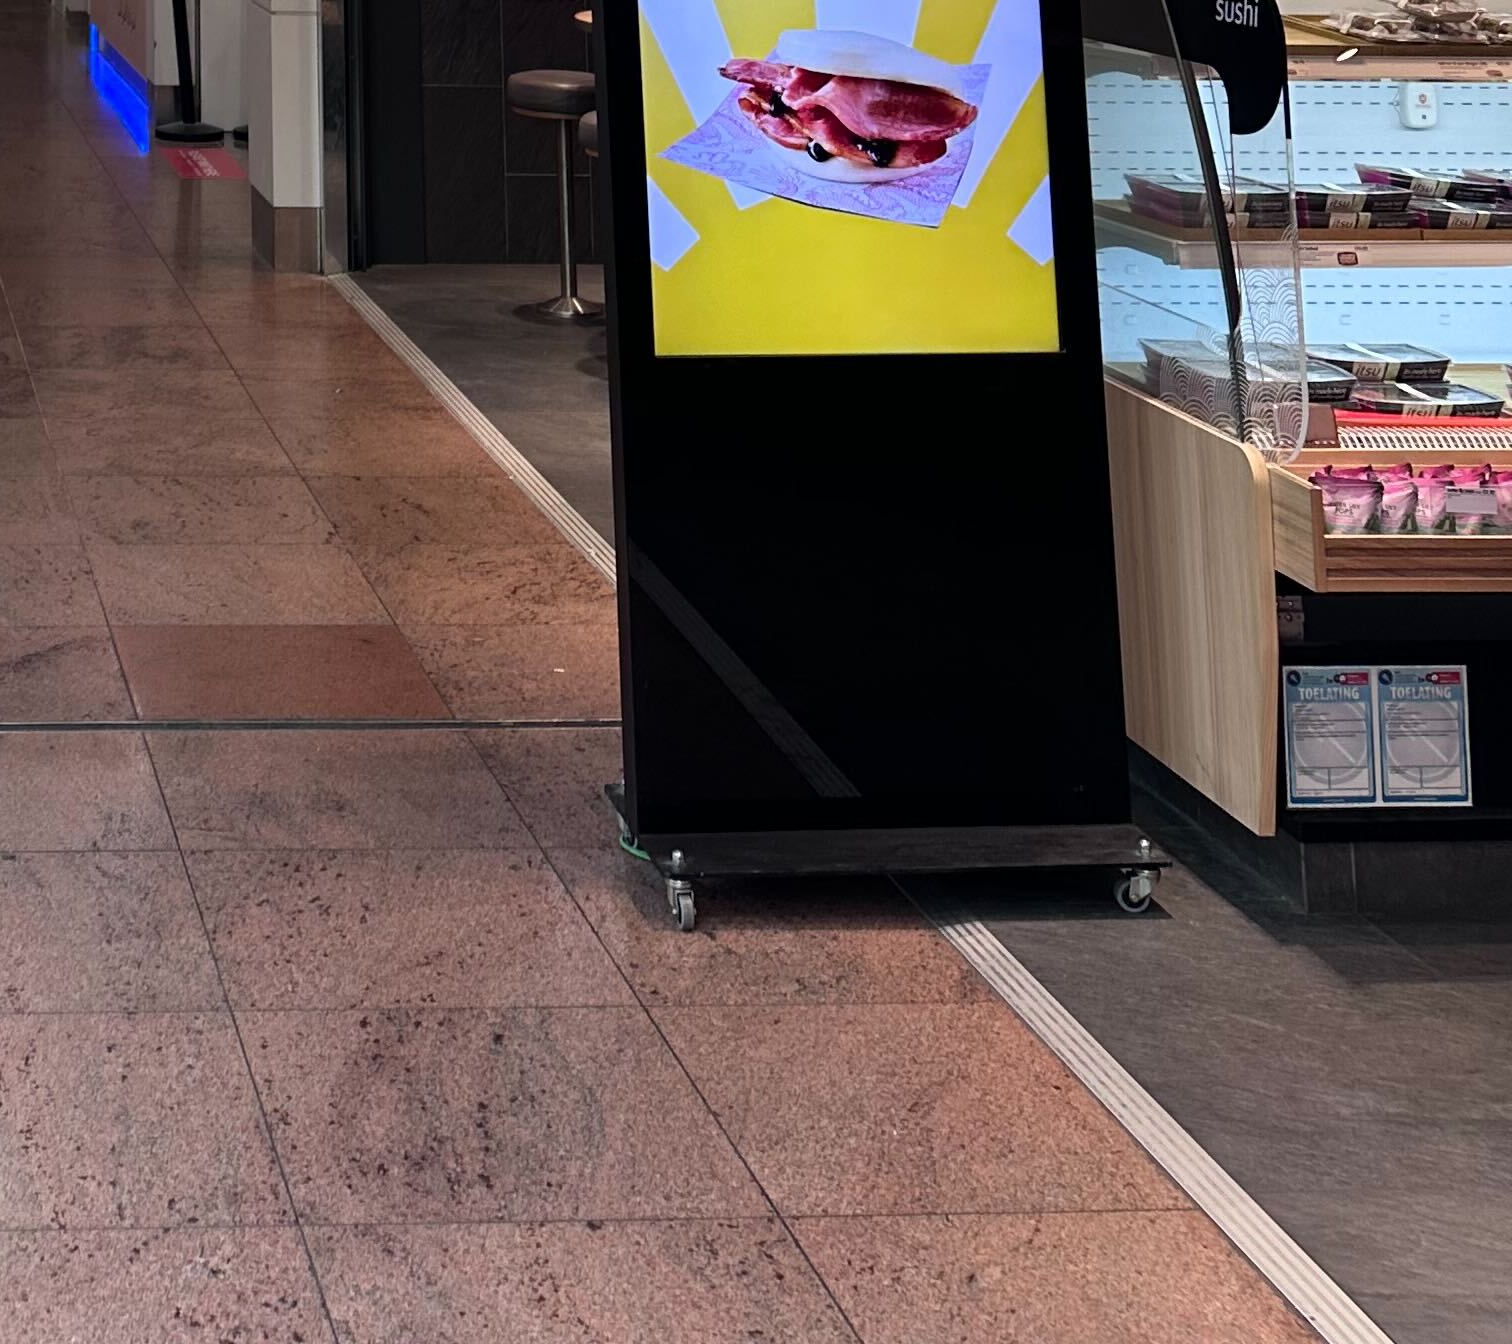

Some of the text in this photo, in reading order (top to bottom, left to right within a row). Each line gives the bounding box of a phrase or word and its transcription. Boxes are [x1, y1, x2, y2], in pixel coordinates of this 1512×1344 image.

[1354, 364, 1382, 378] itsu
[1298, 687, 1360, 701] TOELATING
[1390, 685, 1452, 700] TOELATING
